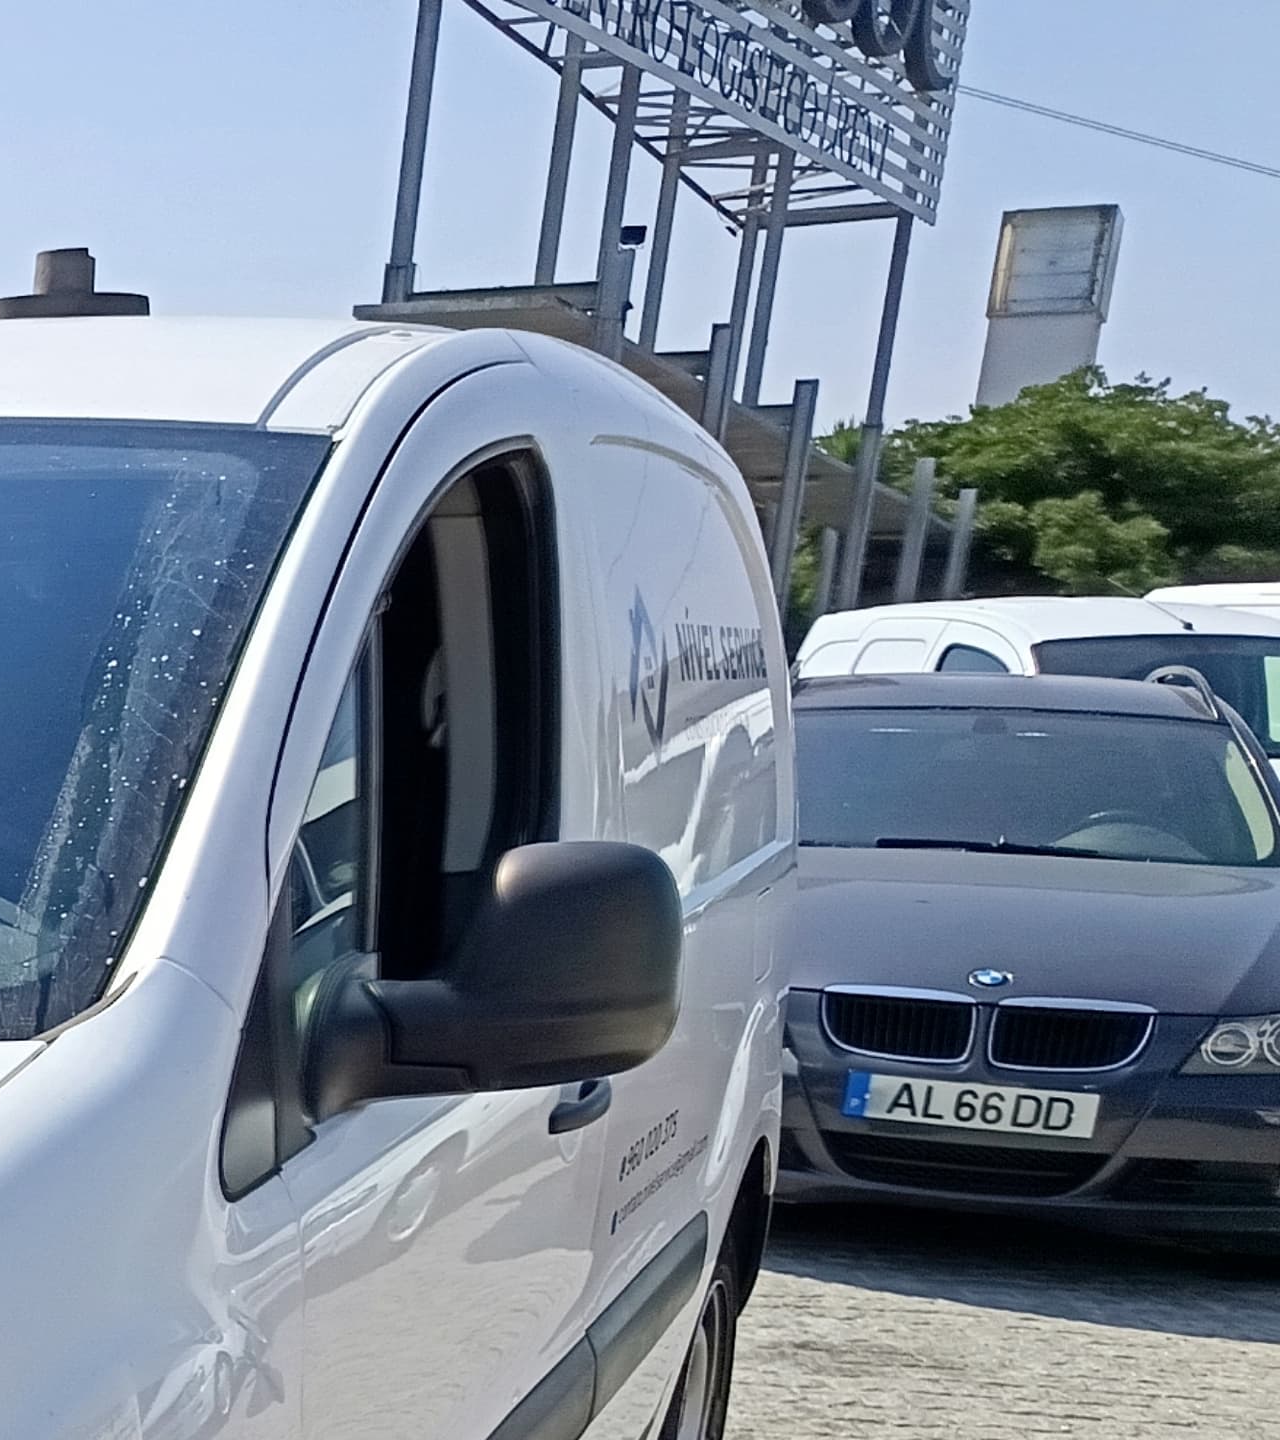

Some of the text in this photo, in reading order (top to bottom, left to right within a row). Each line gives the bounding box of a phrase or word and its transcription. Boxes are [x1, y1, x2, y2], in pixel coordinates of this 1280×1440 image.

[886, 1082, 1076, 1132] AL 66 DD
